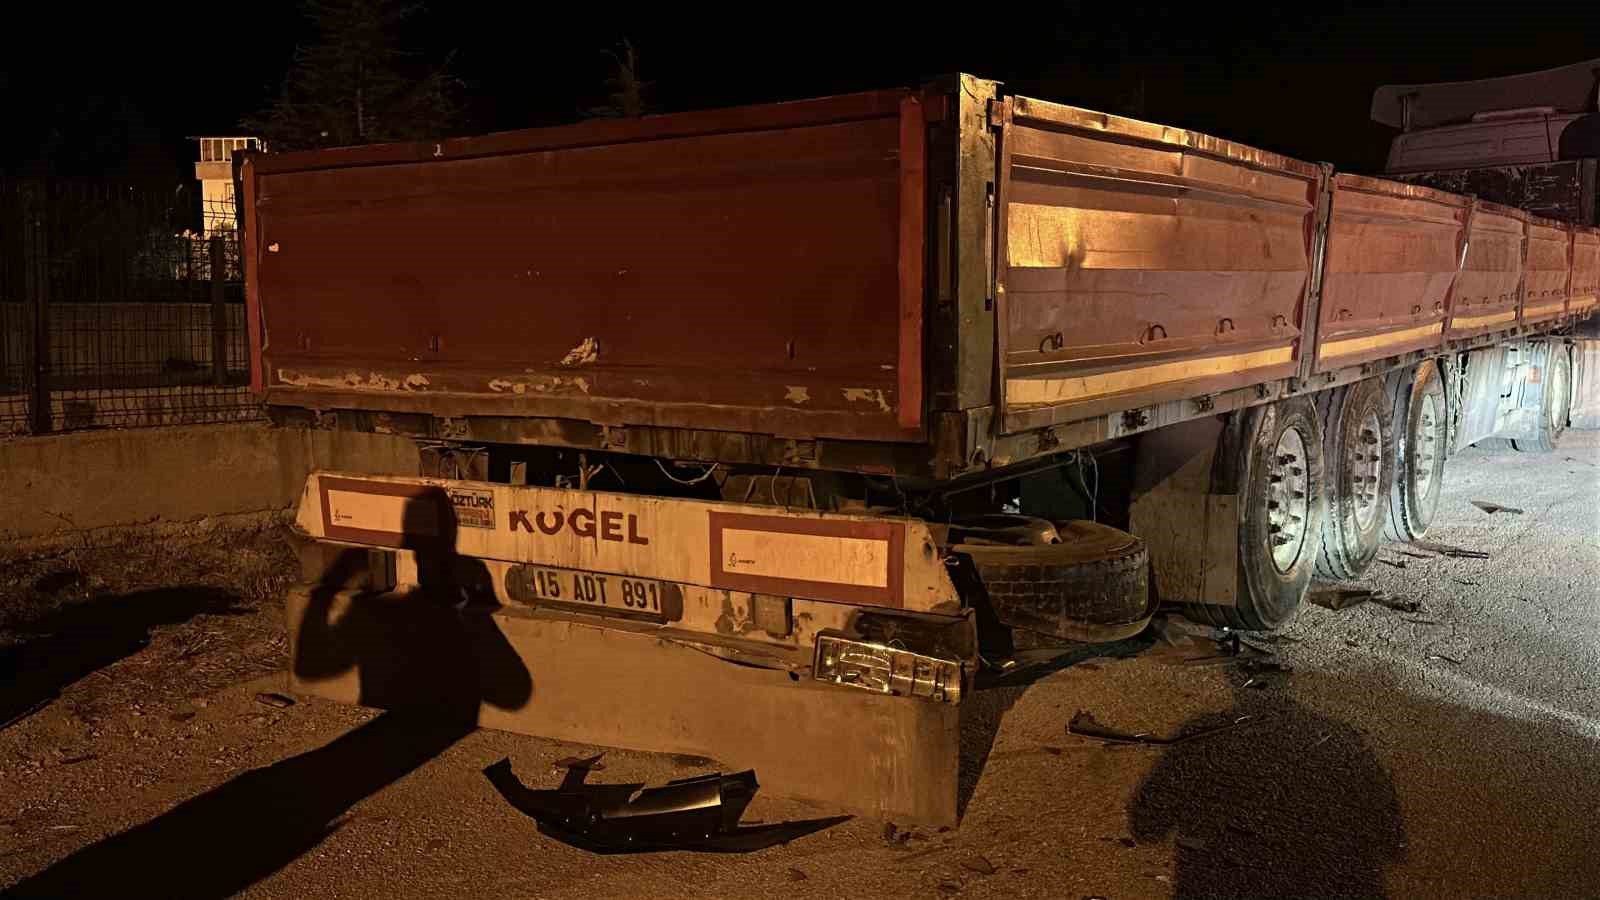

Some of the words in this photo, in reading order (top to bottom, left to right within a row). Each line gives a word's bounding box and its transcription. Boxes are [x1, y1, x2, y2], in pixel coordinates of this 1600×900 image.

[536, 570, 561, 598] 15
[573, 574, 608, 605] ADT
[621, 579, 659, 612] 891
